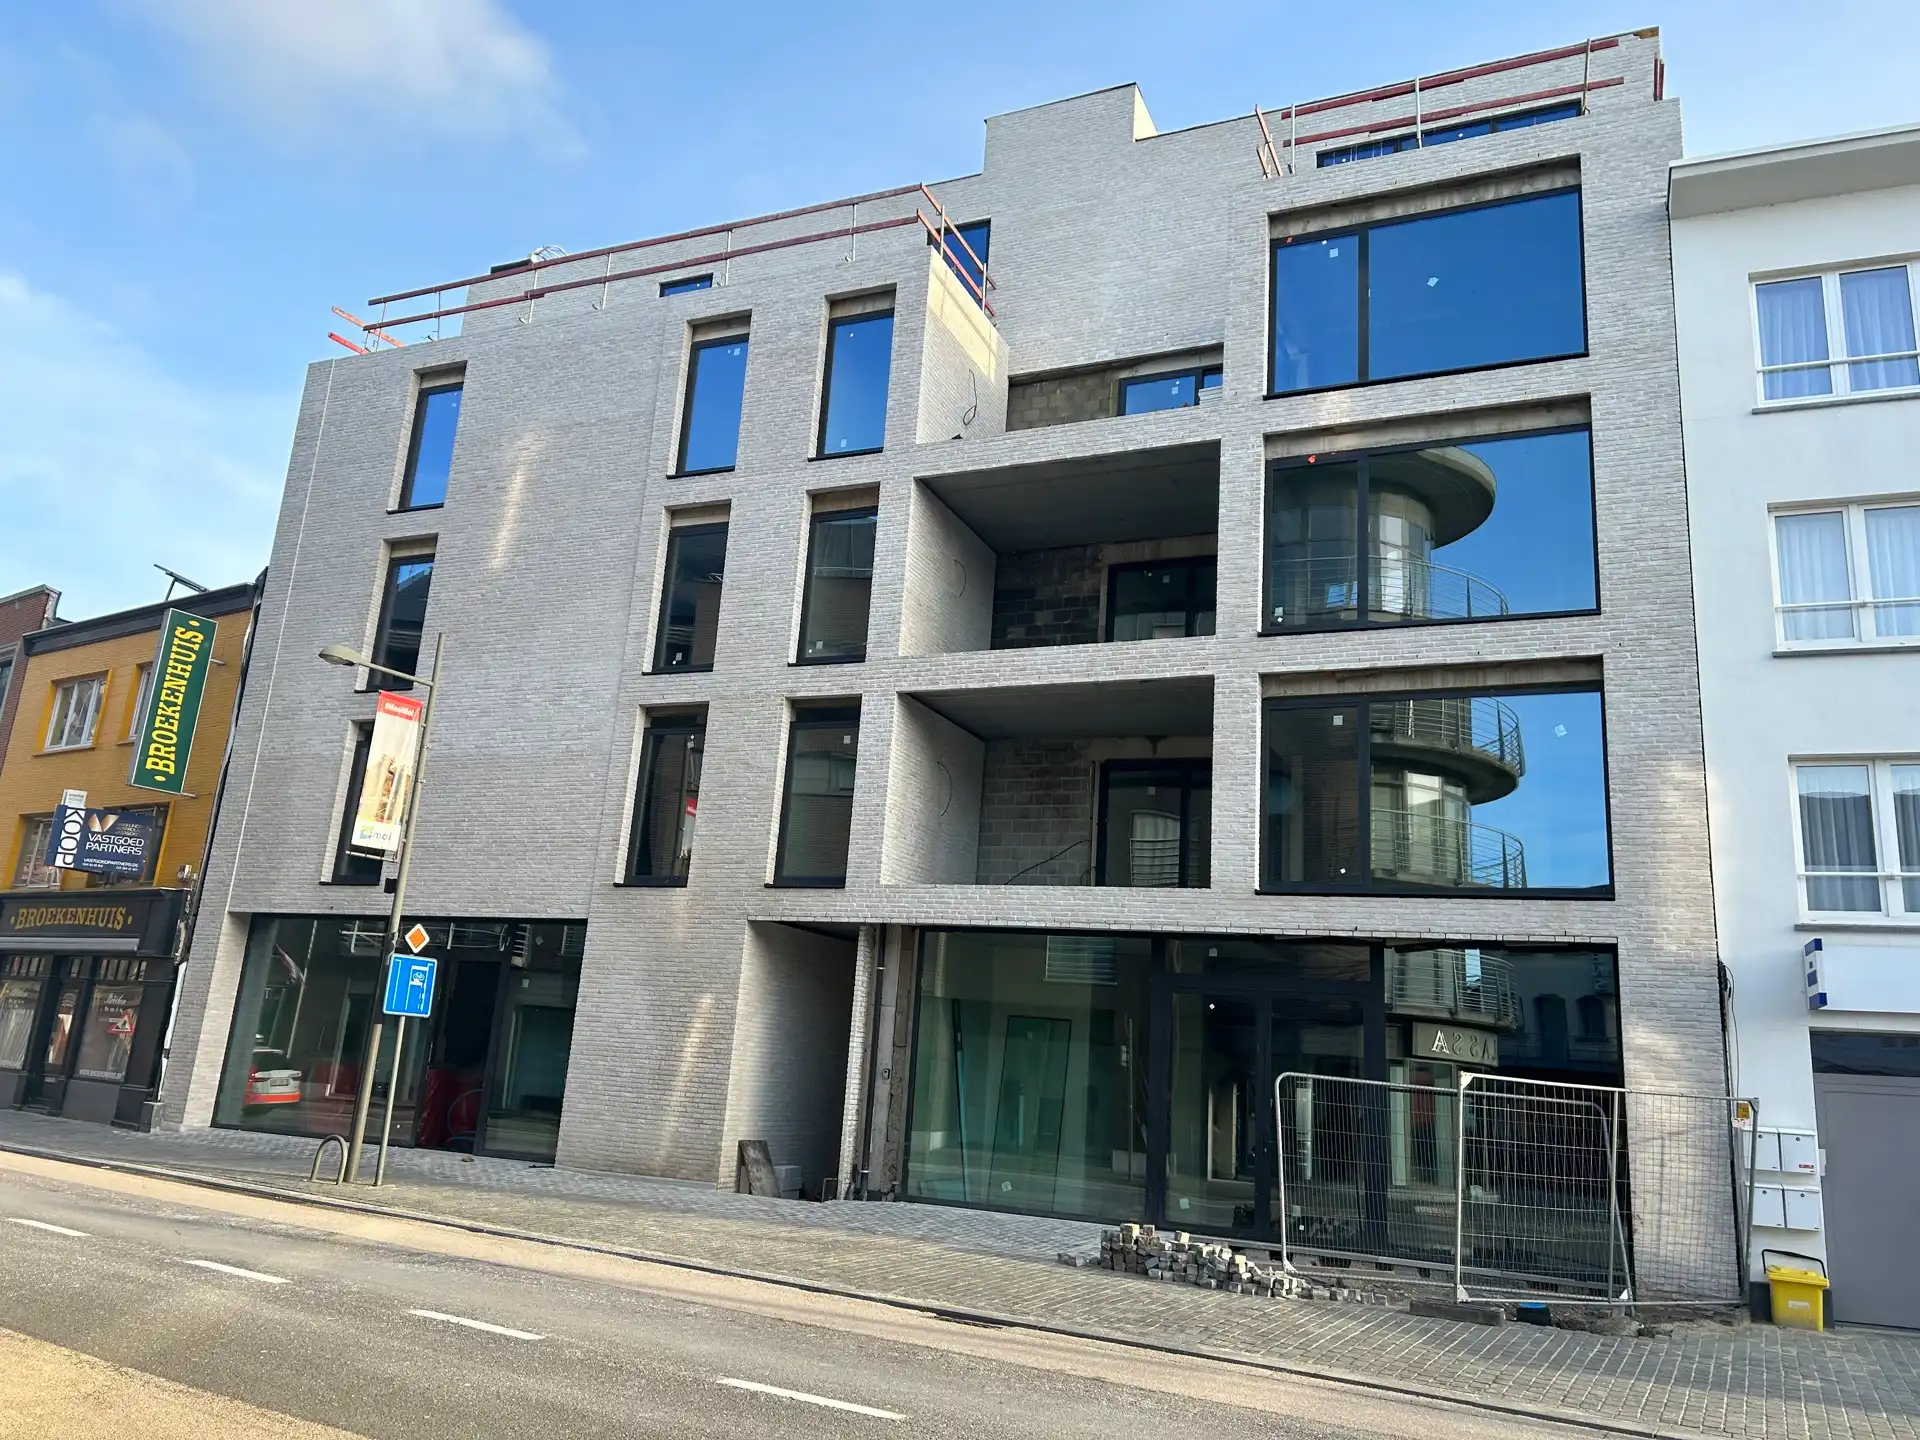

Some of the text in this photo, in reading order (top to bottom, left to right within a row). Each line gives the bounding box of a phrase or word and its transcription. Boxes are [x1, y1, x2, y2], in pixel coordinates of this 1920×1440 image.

[145, 626, 204, 775] BROEKENHUIS
[58, 806, 86, 866] KOOP
[88, 833, 145, 847] VASTGOED
[372, 831, 392, 841] mol
[85, 841, 142, 856] PARTNERS
[14, 907, 127, 930] BROEKENHUIS
